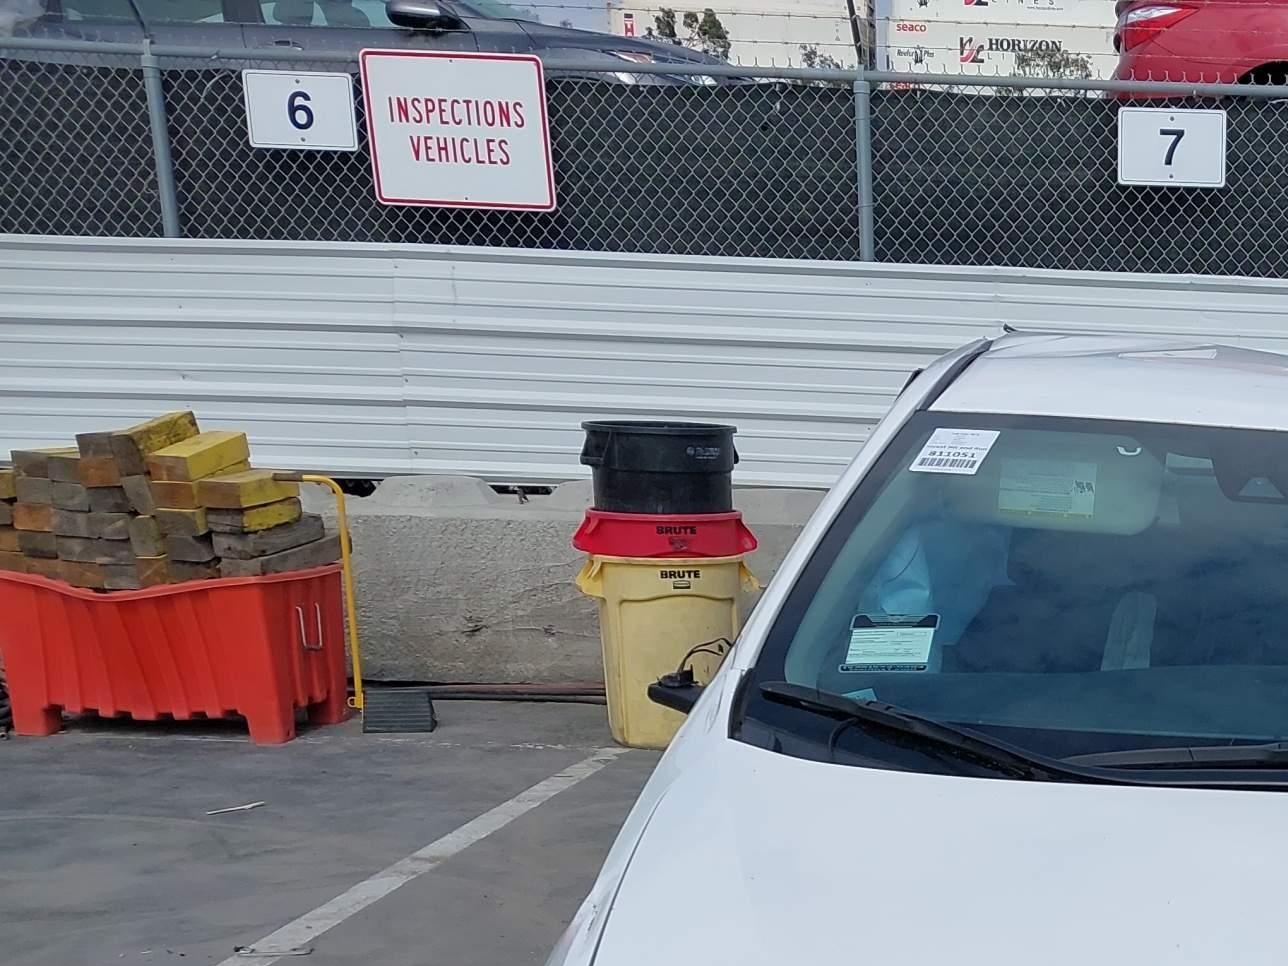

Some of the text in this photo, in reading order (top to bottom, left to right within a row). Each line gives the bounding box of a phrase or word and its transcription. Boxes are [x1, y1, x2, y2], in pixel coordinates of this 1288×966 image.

[896, 23, 926, 32] seaco
[987, 38, 1062, 52] HORIZON
[287, 91, 314, 130] 6
[388, 96, 525, 128] INSPECTIONS
[410, 136, 511, 165] VEHICLES
[1159, 128, 1185, 166] 7
[928, 450, 977, 458] 811051
[656, 525, 697, 535] BRUTE
[660, 570, 701, 579] BRUTE
